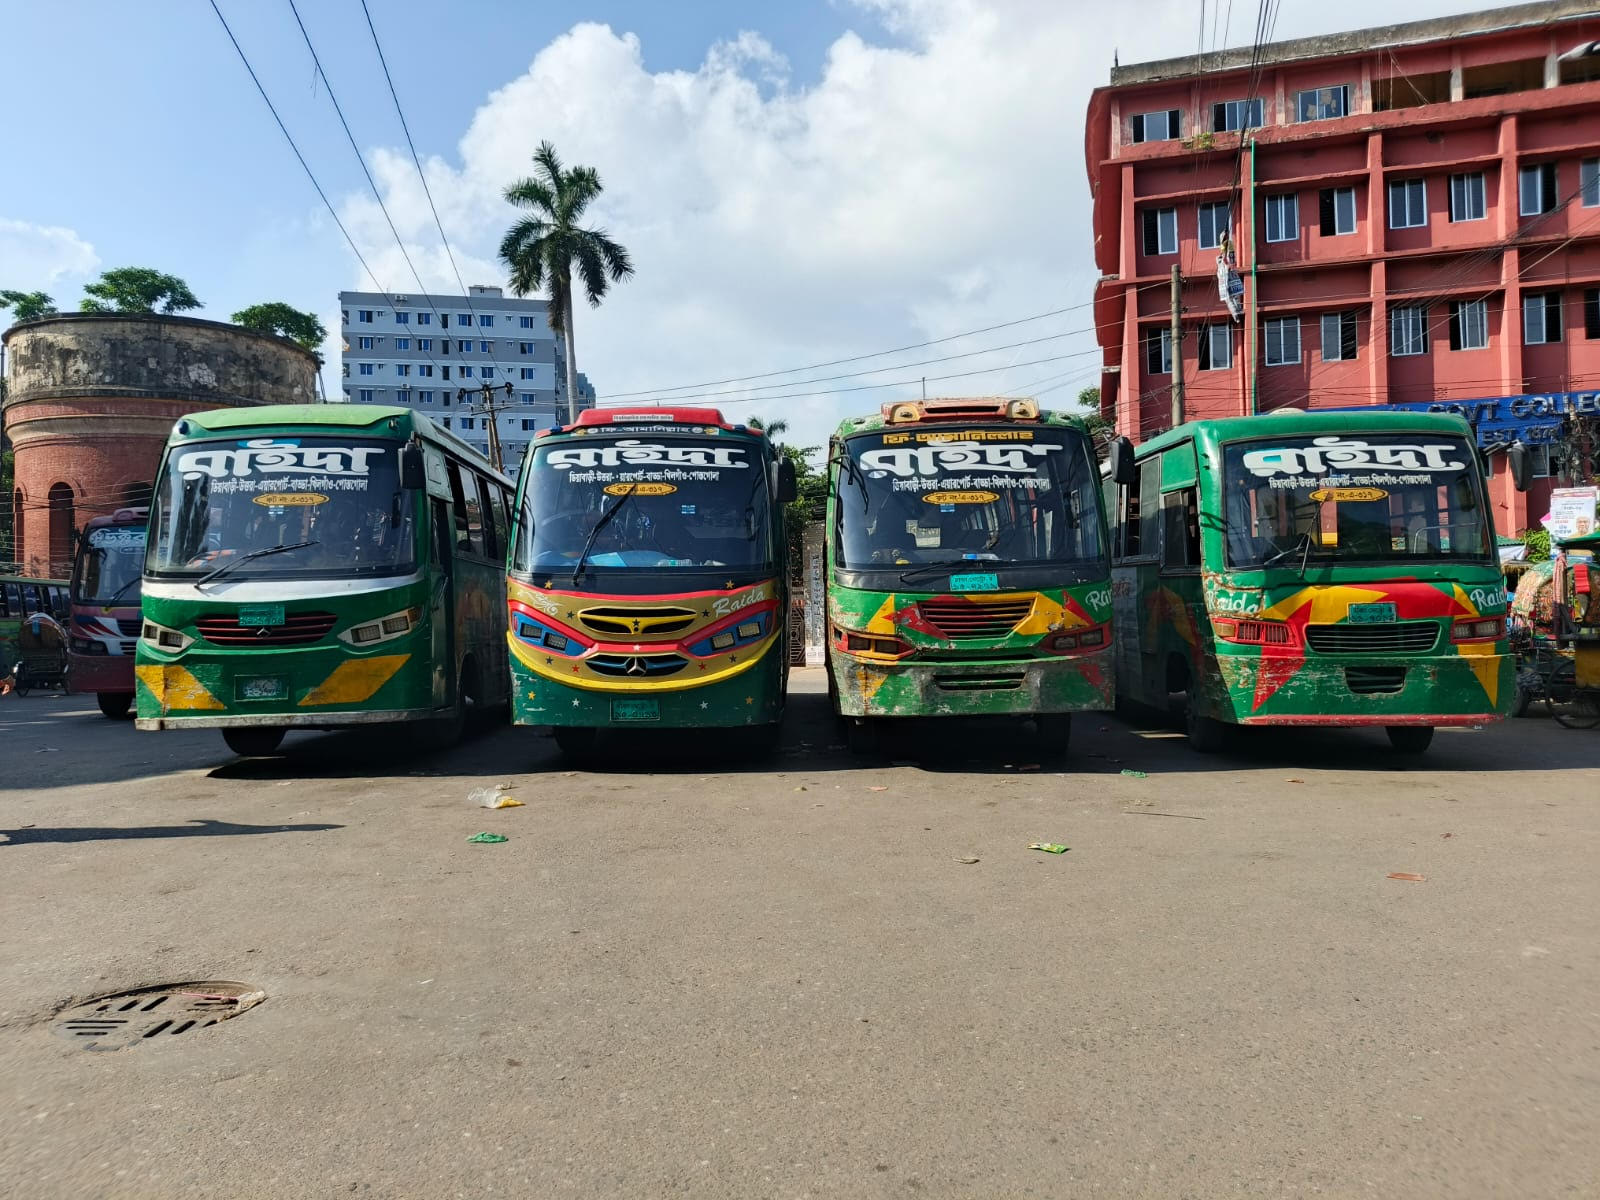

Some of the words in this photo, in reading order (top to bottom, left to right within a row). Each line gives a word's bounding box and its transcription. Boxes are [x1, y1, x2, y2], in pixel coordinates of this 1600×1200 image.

[178, 438, 385, 480] রাইদা
[547, 439, 750, 469] রাইদা
[1242, 436, 1466, 477] রাইদা
[712, 589, 765, 617] Raida
